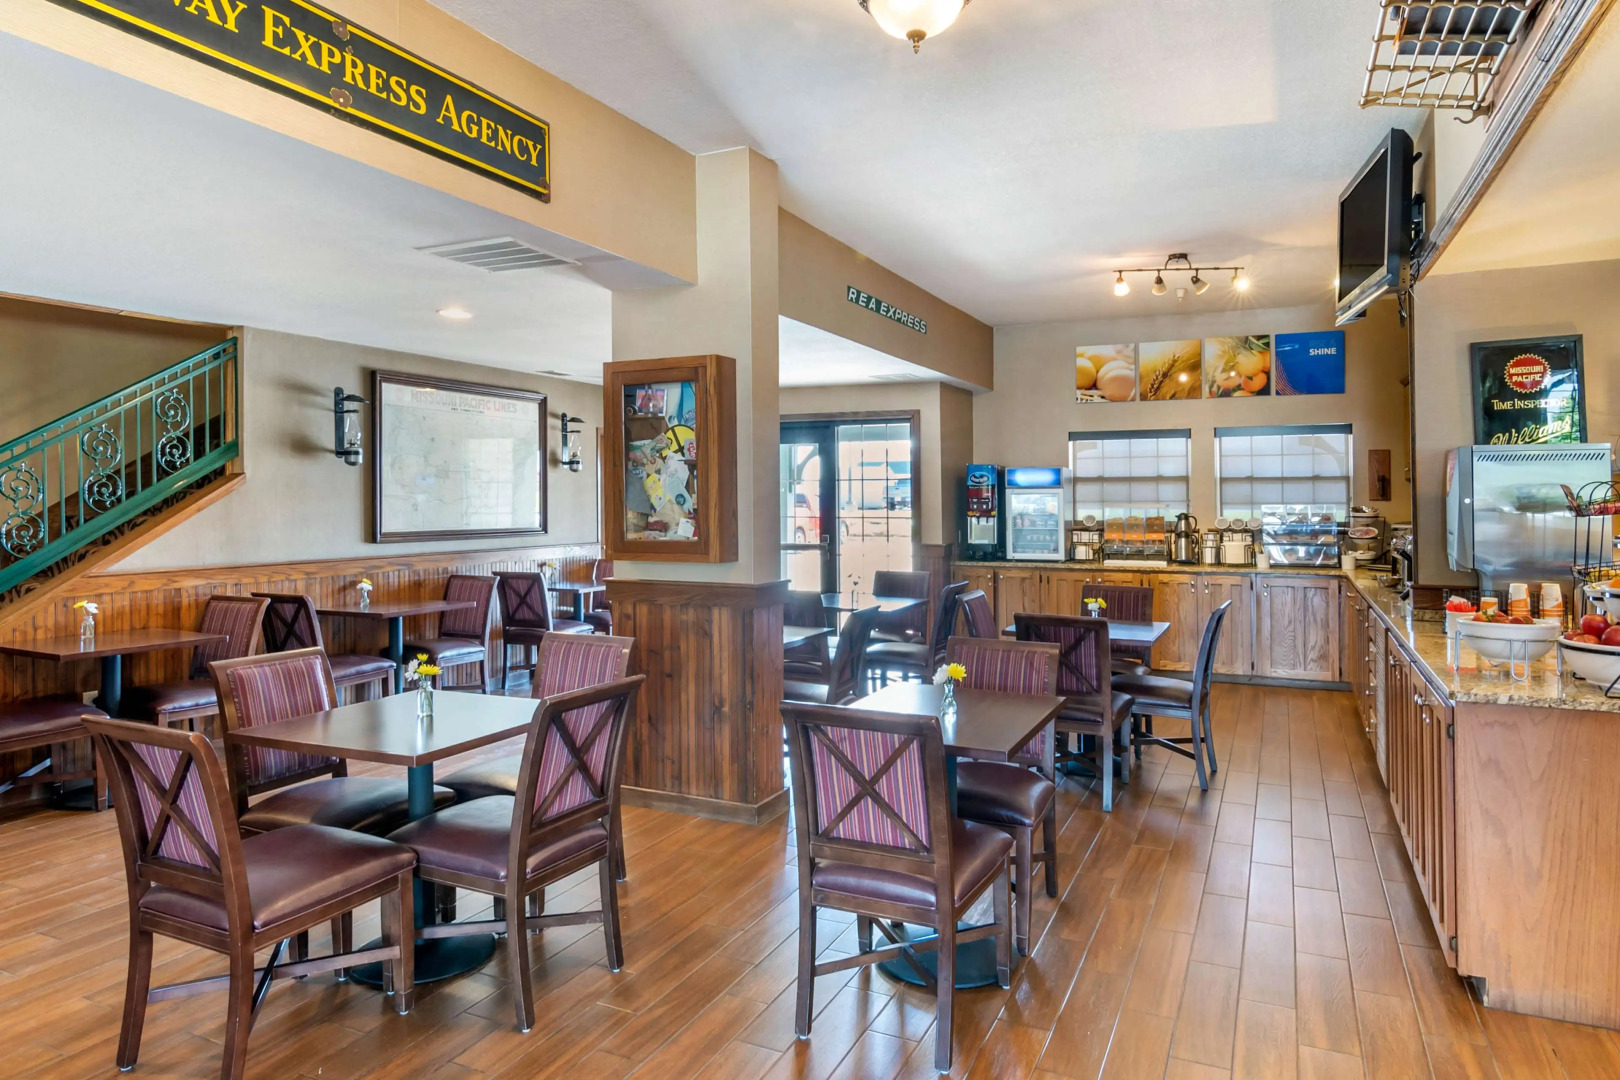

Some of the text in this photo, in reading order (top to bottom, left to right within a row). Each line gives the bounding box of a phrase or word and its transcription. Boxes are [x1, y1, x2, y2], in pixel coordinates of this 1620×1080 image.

[173, 0, 543, 167] AY EXPRESS AGENCY
[879, 302, 927, 333] EXPRESS
[1309, 347, 1337, 356] SHINE
[1509, 365, 1544, 374] MISSOURI
[1512, 373, 1543, 382] PACIFIC
[410, 389, 457, 407] MISSOURI
[459, 395, 491, 411] PACIFIC
[493, 401, 518, 414] LINES
[1491, 397, 1568, 410] TIME INSPECOR
[1490, 414, 1571, 445] Williams
